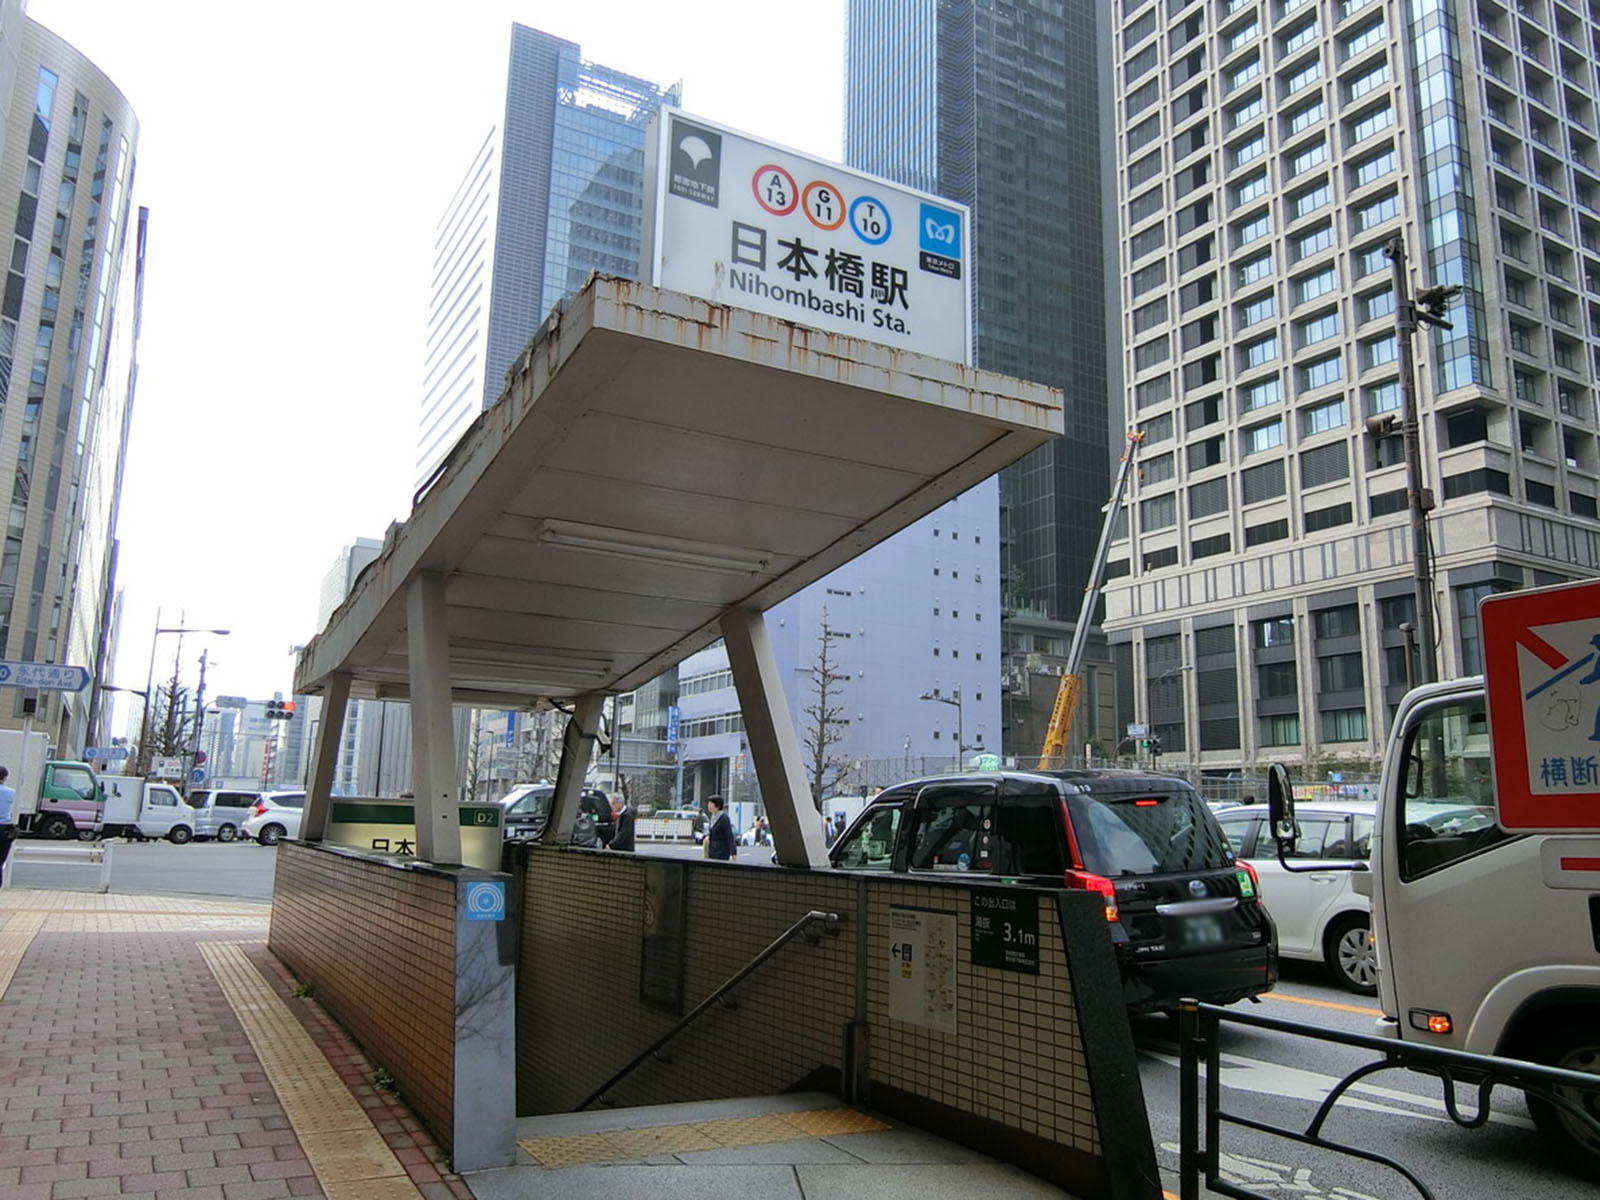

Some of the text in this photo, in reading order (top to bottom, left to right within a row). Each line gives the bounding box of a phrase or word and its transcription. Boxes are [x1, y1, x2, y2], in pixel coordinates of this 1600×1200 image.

[770, 174, 782, 189] A
[765, 187, 786, 206] 13
[817, 189, 830, 204] G
[815, 203, 832, 221] 11
[867, 204, 875, 217] T
[862, 218, 881, 235] 10
[731, 220, 909, 311] 日本橋駅
[729, 268, 911, 335] Nihombashi Sta.
[1540, 756, 1599, 787] 横断
[477, 812, 494, 823] D2
[974, 896, 1017, 911] この出入口は
[1004, 923, 1035, 944] 3.1m
